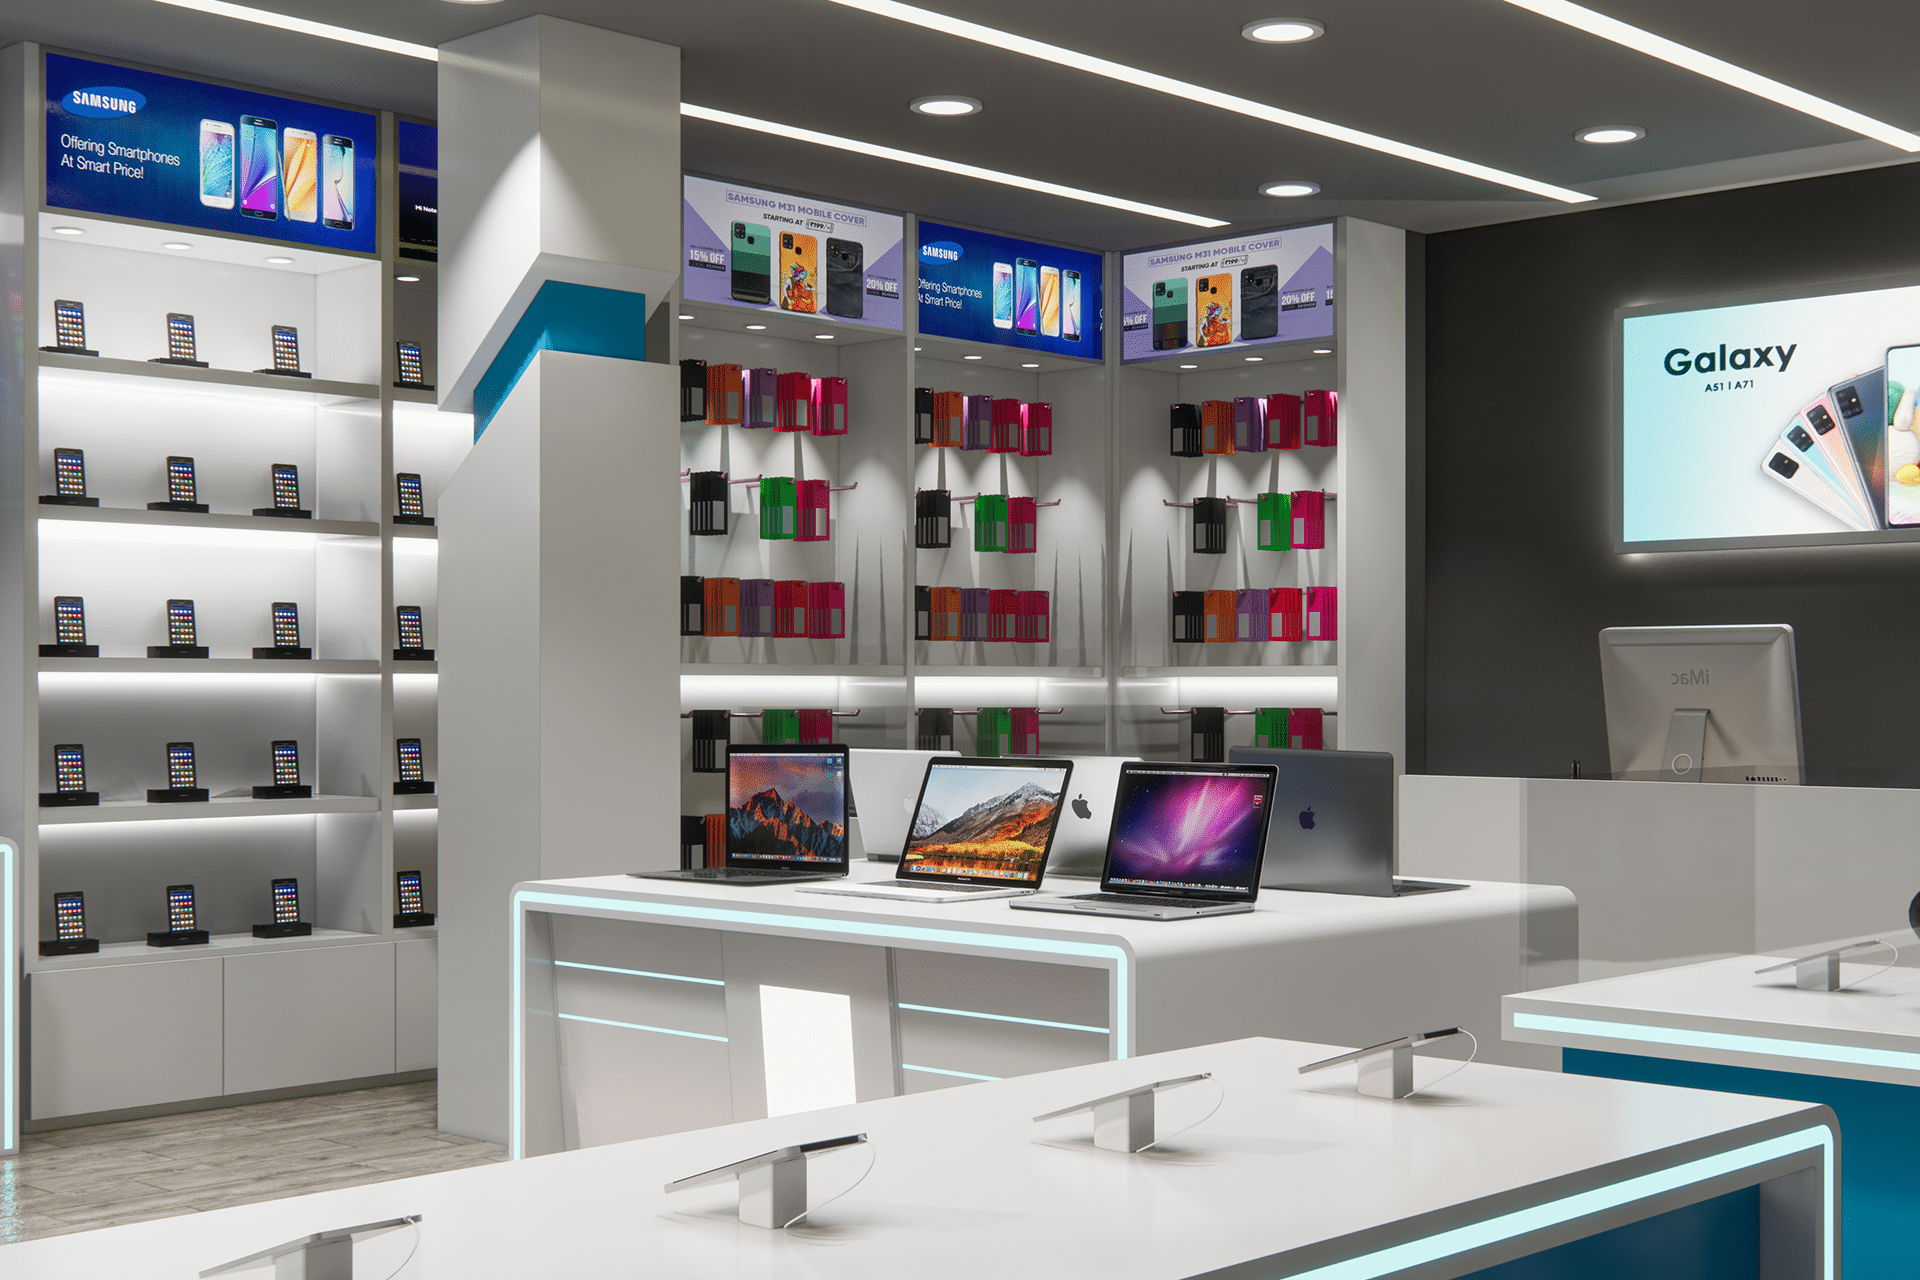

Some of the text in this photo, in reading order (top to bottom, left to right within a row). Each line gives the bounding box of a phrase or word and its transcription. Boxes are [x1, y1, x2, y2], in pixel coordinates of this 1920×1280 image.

[73, 90, 137, 114] SAMSUNG
[60, 133, 181, 167] Offering Smartphones
[61, 153, 144, 179] At Smart Price!
[728, 192, 865, 225] SAMSUNG M31 MOBILE COVER
[763, 213, 794, 224] STARTING
[795, 218, 804, 226] AT
[690, 249, 709, 262] 15%
[709, 252, 725, 265] OFF
[922, 245, 958, 261] SAMSUNG
[1149, 239, 1280, 265] SAMSUNG M31 MOBILE COVER
[1181, 262, 1210, 272] STARTING
[866, 278, 884, 291] 20%
[884, 281, 899, 293] OFF
[941, 281, 983, 299] Smartphones
[924, 293, 944, 307] Smart
[944, 296, 963, 310] Price!
[1281, 291, 1316, 305] 20% OFF
[1134, 314, 1148, 325] OFF
[1663, 343, 1798, 376] Galaxy
[1705, 381, 1725, 392] A51
[1734, 379, 1755, 390] A71
